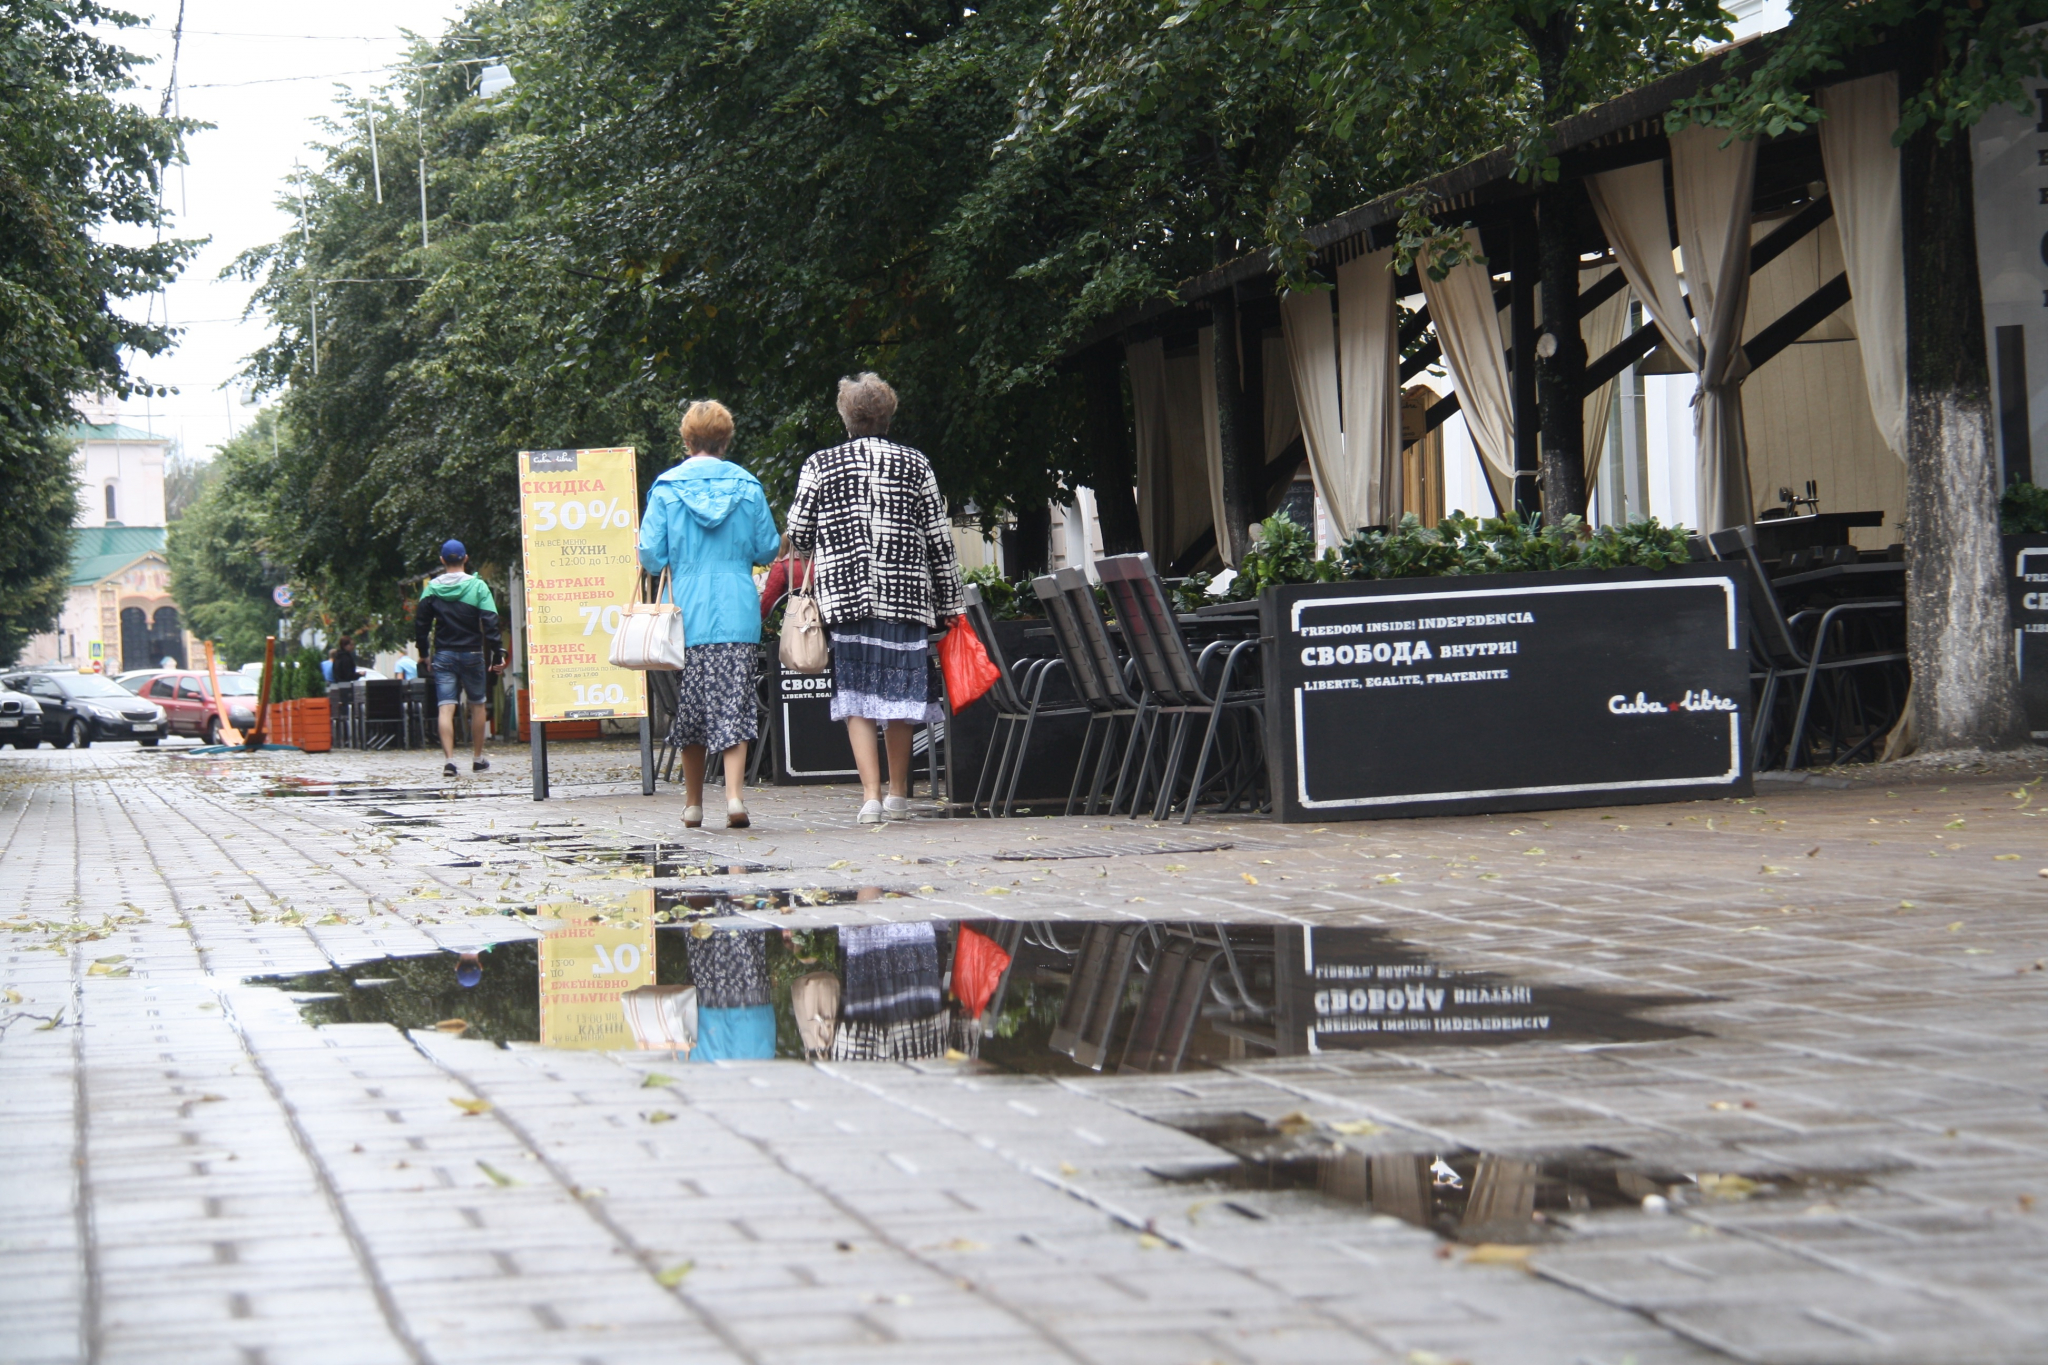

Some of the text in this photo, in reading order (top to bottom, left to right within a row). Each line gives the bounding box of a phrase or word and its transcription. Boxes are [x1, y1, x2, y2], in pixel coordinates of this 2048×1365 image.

[522, 479, 606, 496] СКИДКА
[533, 497, 630, 532] 30%
[561, 545, 606, 556] КУХНИ
[560, 556, 586, 566] 12:00
[589, 558, 601, 566] до
[604, 554, 631, 564] 17:00
[527, 577, 605, 589] ЗАВТРАКИ
[537, 590, 614, 602] ЕЖЕДНЕВНО
[537, 606, 551, 614] ДО
[1301, 612, 1534, 637] FREEDOM INSIDE! INDEPEDENCIA
[530, 643, 585, 654] БИЗНЕС
[1301, 640, 1518, 666] СВОБОДА ВНУТРИ!
[540, 654, 596, 665] ЛАНЧИ
[1304, 669, 1509, 692] LIBERTE, EGALITE, FRATERNITE
[1608, 691, 1668, 714] Cuba
